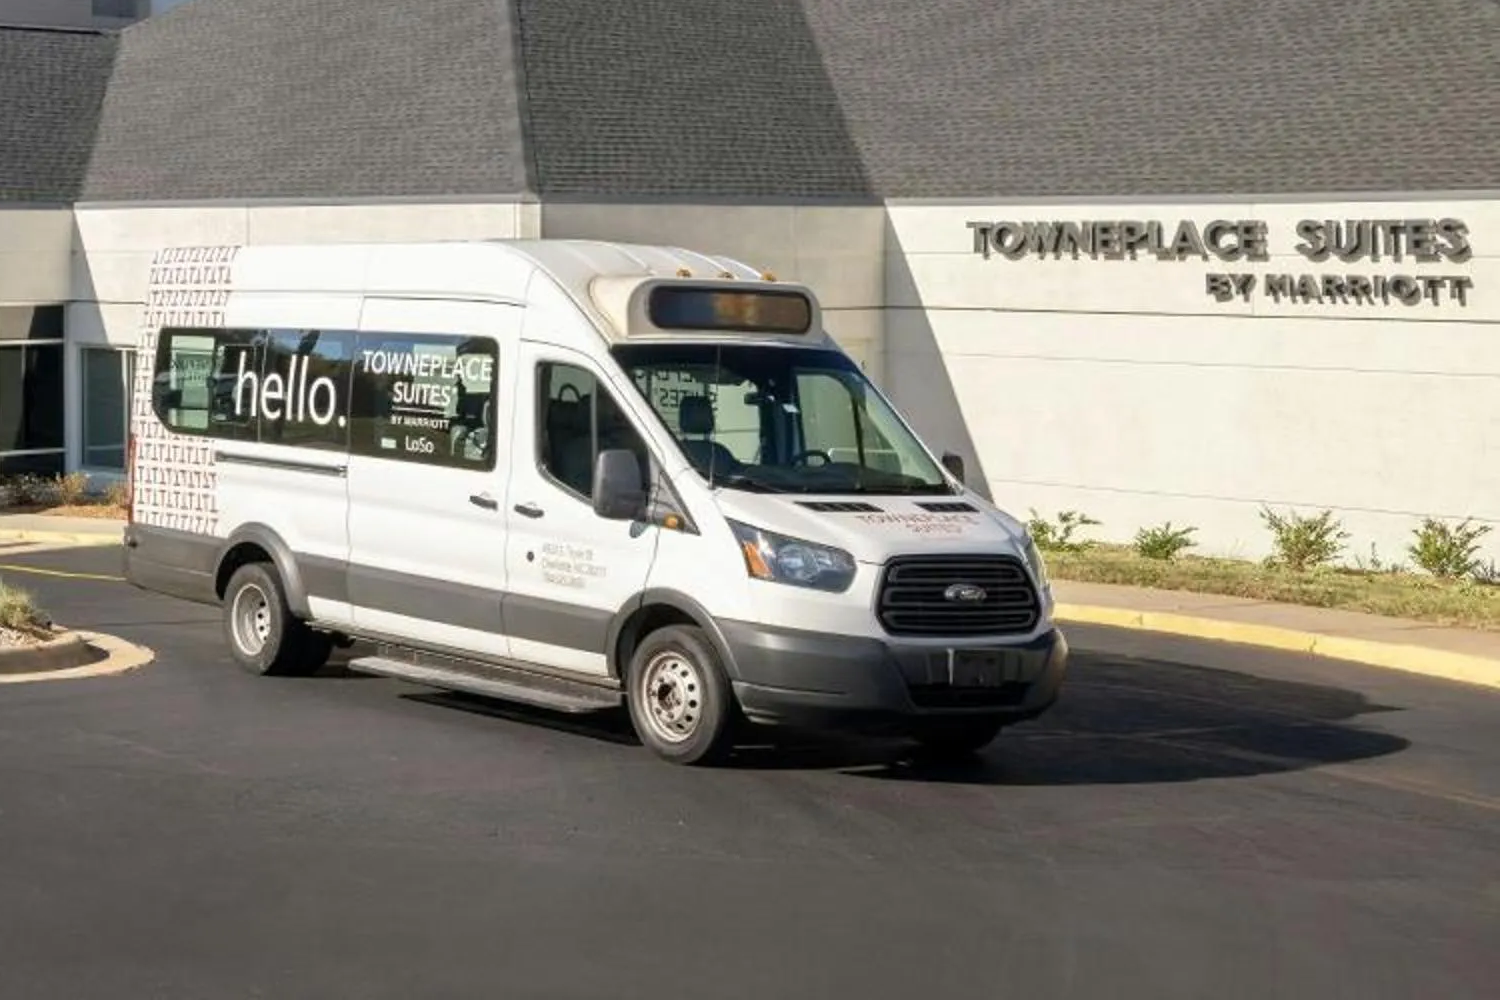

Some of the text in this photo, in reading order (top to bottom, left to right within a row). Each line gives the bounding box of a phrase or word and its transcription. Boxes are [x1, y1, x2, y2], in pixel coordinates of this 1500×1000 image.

[966, 218, 1473, 262] TOWNEPLACE SUITES
[1206, 273, 1473, 306] BY MARRIOTT
[363, 350, 493, 381] TOWNEPLACE
[235, 350, 346, 428] hello.
[393, 381, 451, 406] SUITES
[405, 435, 435, 453] LoSo
